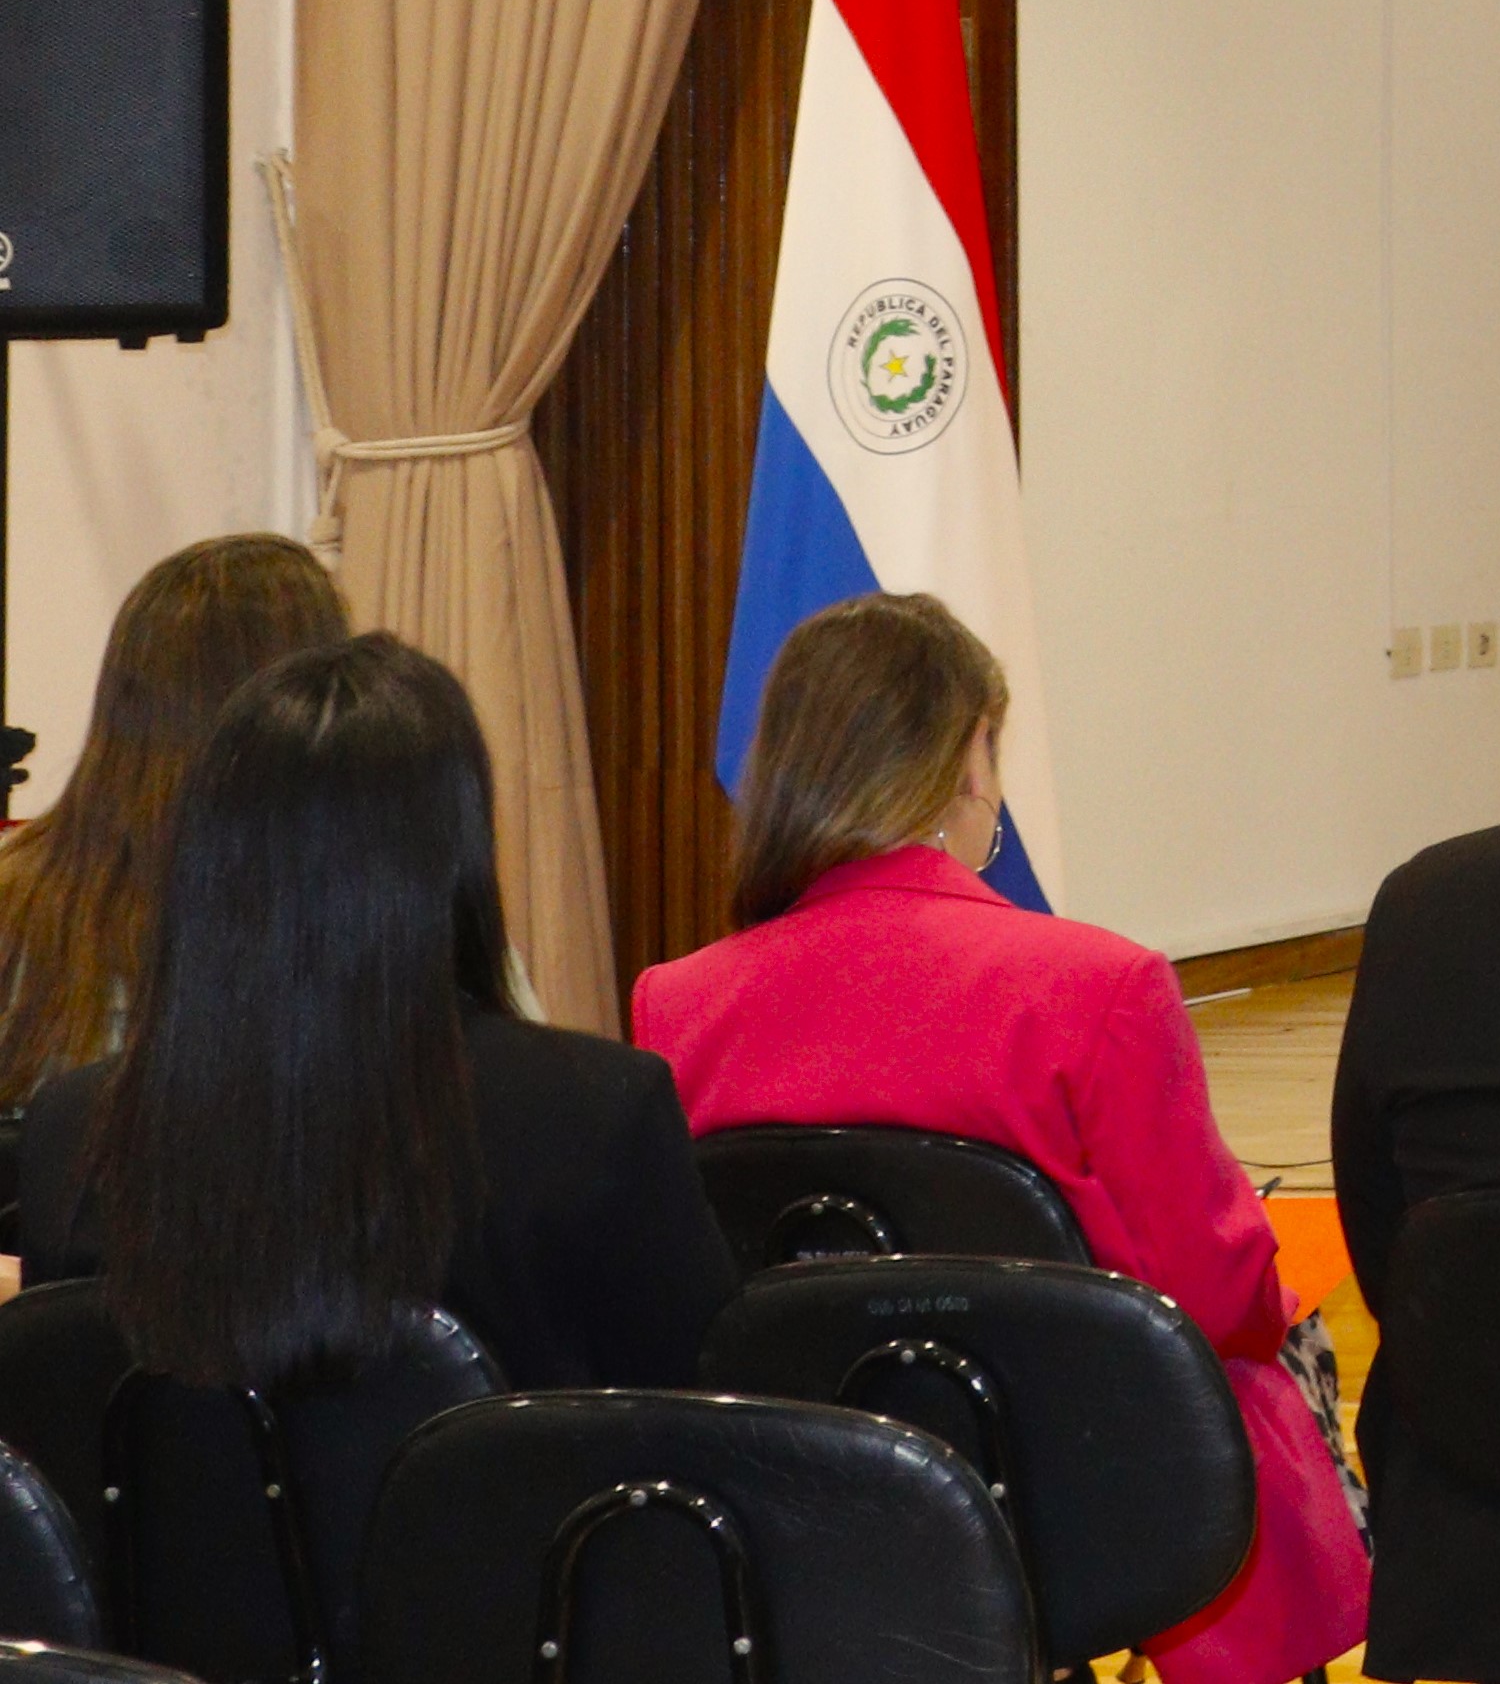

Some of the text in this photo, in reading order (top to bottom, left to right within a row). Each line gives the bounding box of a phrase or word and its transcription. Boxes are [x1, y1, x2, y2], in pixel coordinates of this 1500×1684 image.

[848, 297, 953, 436] REPUBLICA DEL PARAGUAY
